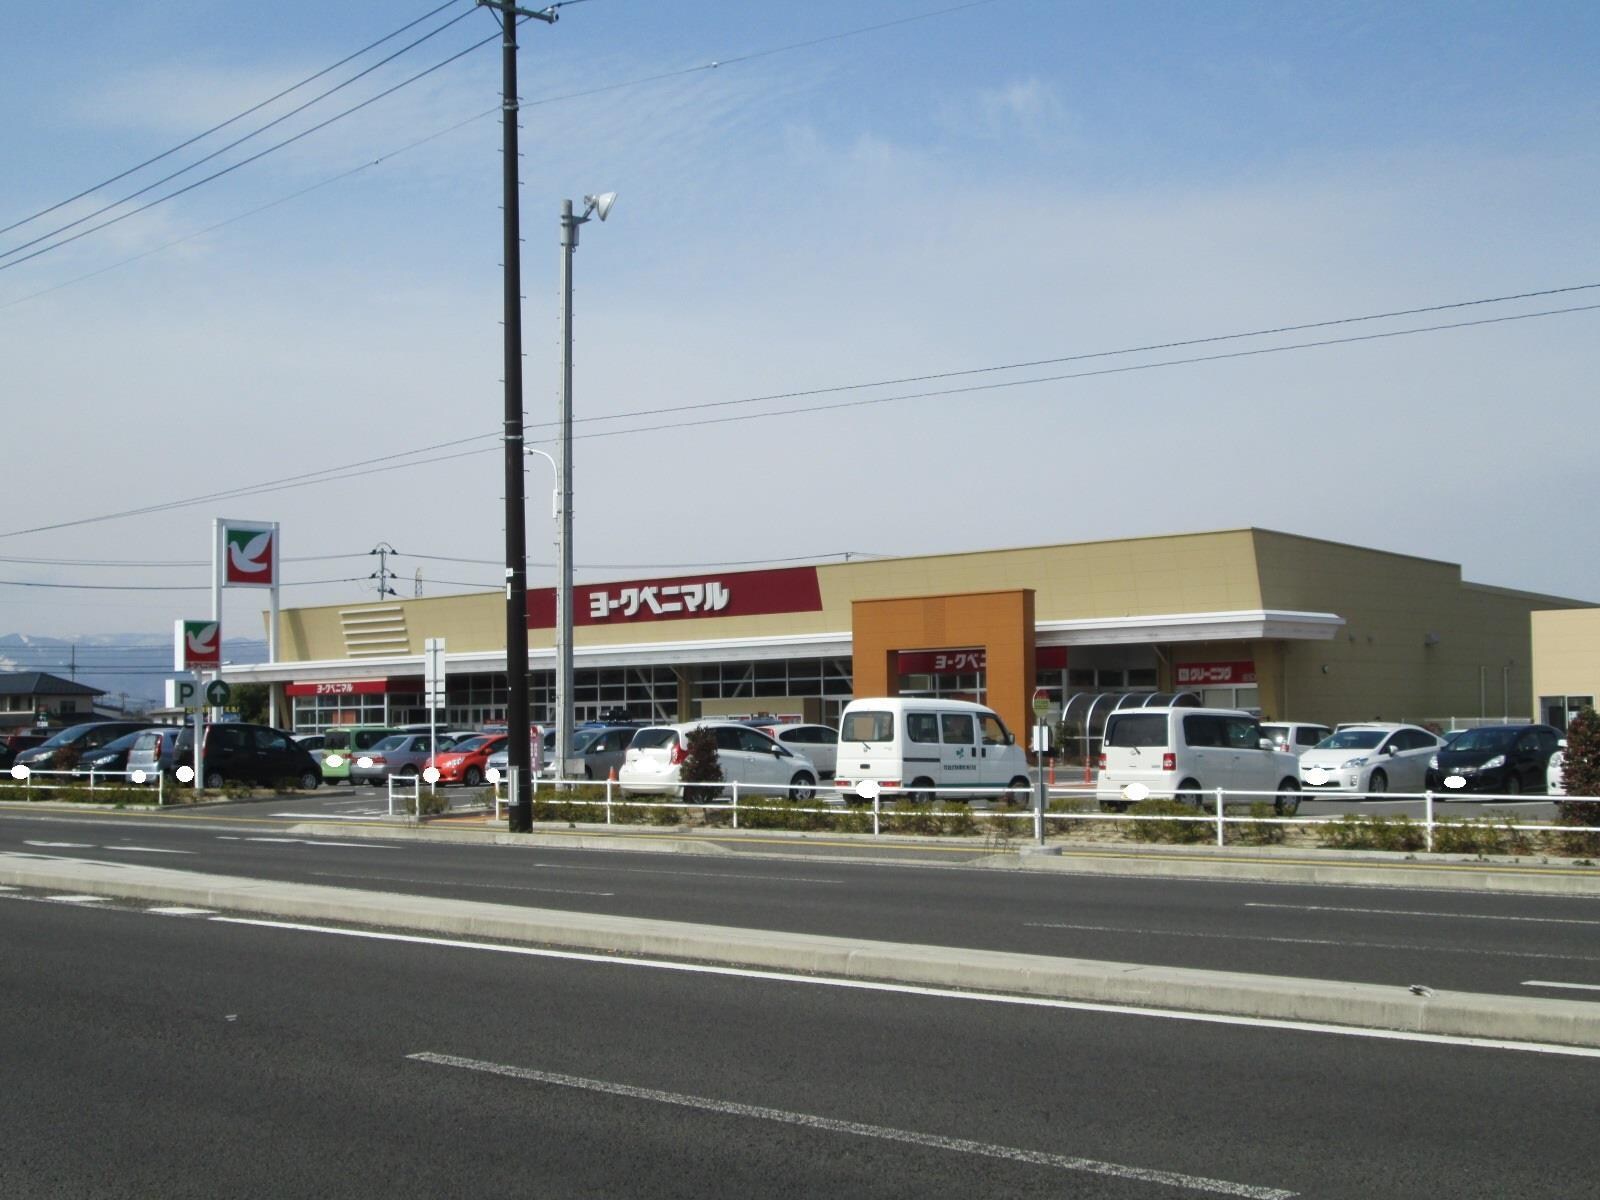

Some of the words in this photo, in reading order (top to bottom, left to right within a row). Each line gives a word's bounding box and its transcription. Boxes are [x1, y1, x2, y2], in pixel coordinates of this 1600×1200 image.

[589, 582, 730, 618] ヨークベニマル
[1190, 667, 1232, 680] クリーニング
[180, 683, 194, 704] P
